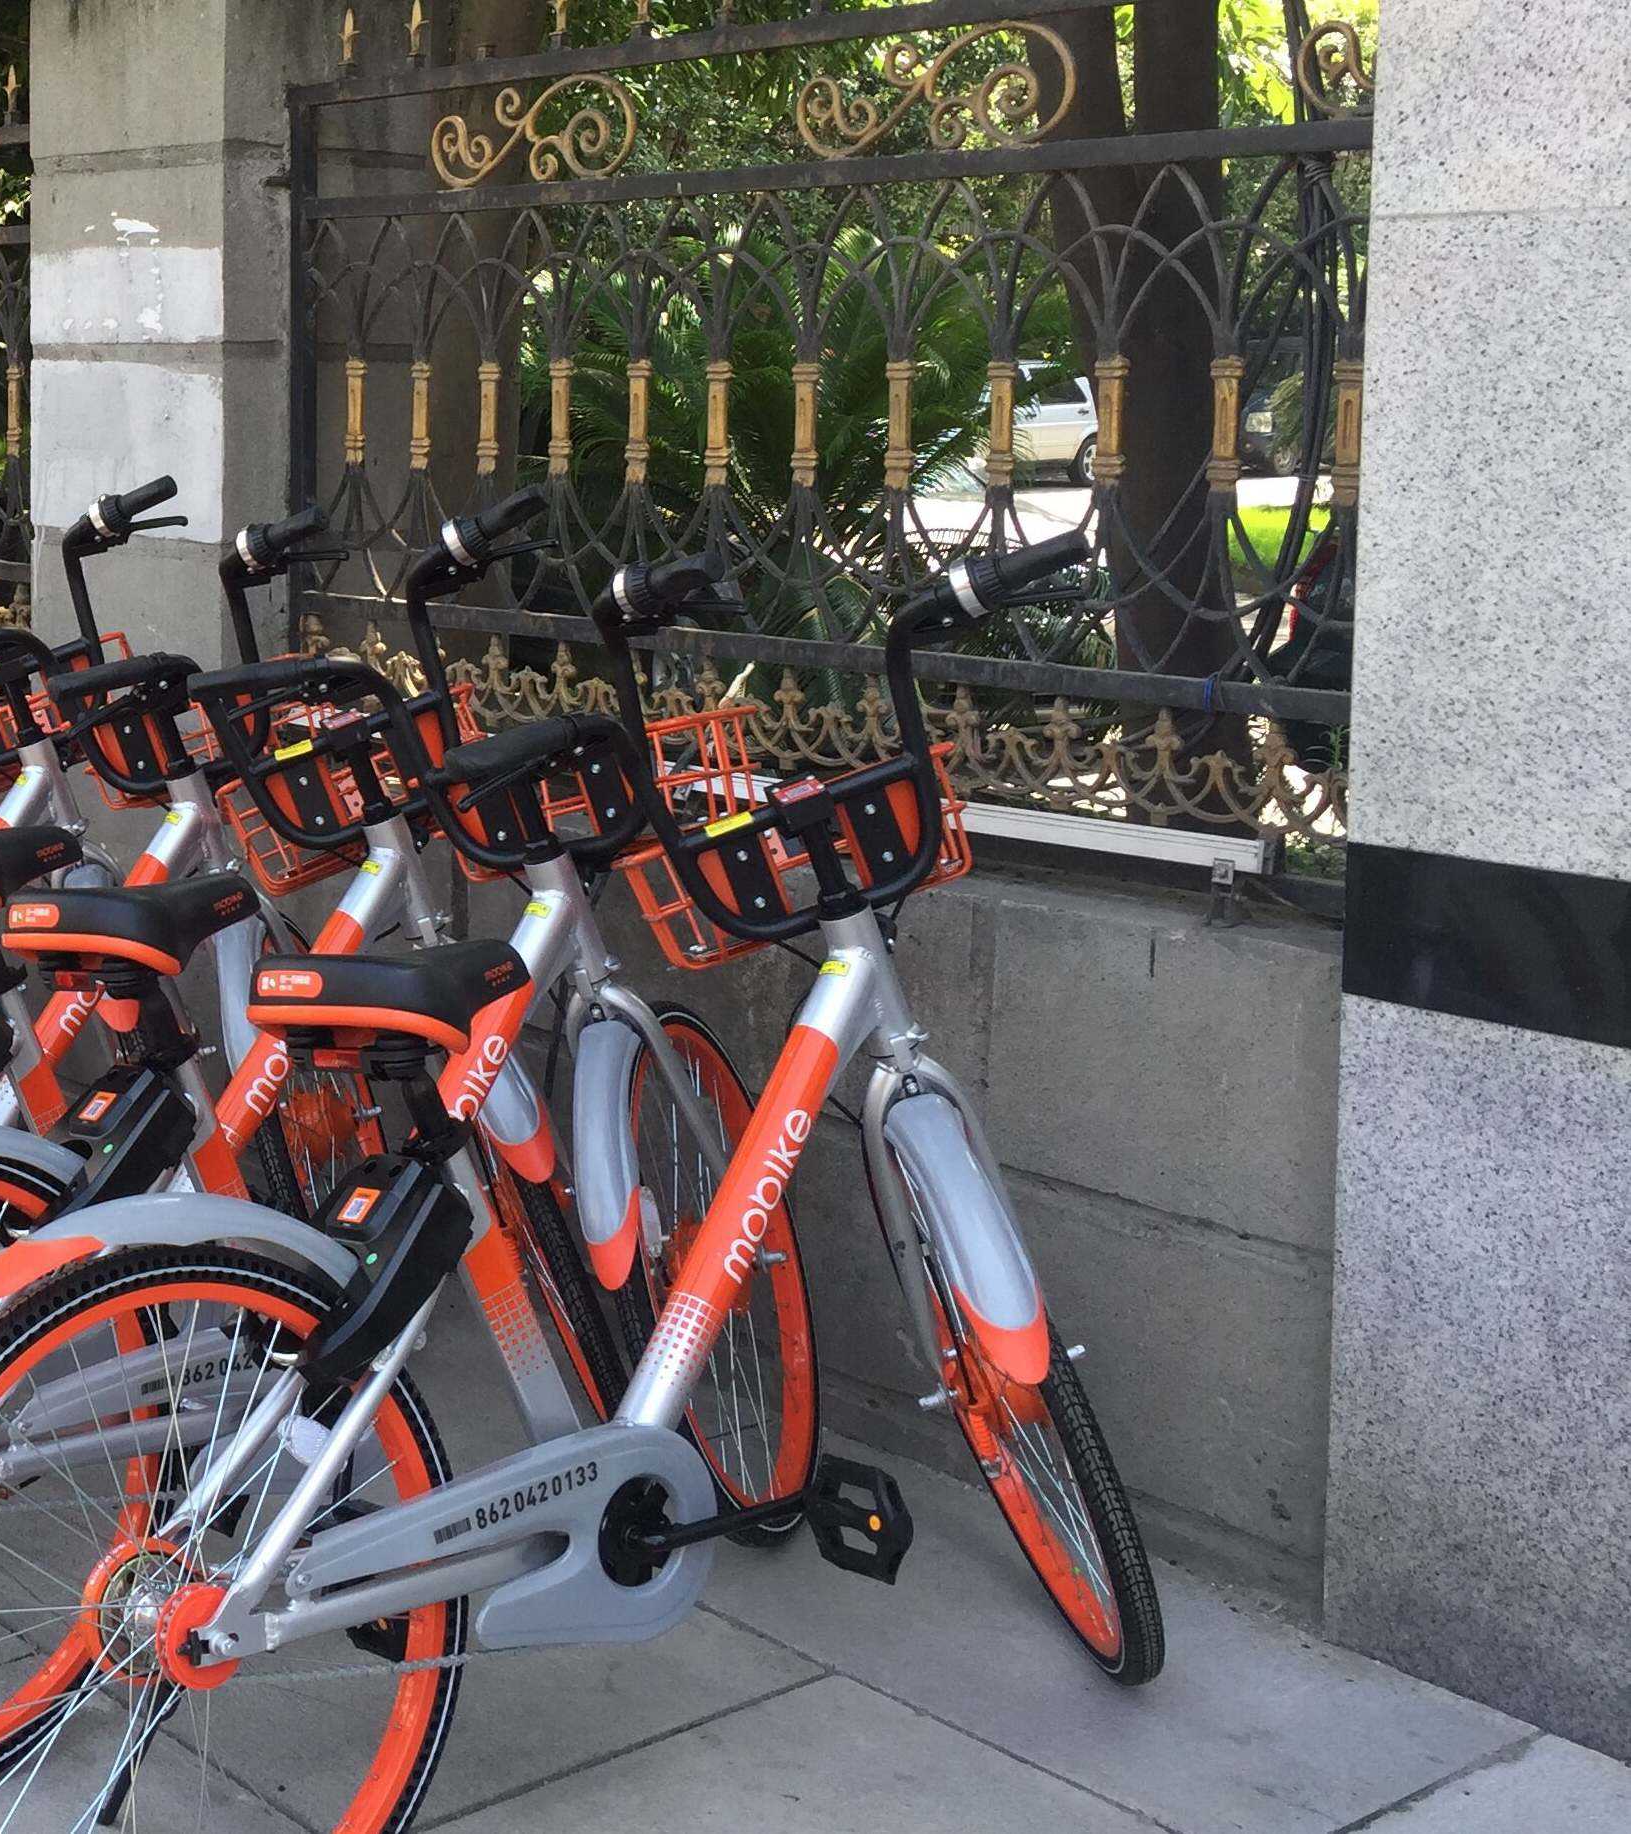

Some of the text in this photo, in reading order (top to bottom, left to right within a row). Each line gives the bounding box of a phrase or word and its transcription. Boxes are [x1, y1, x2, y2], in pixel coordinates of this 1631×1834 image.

[447, 1034, 508, 1122] bike
[723, 1109, 811, 1284] mobike
[182, 1352, 271, 1386] 862042
[475, 1461, 598, 1530] 8620420133
